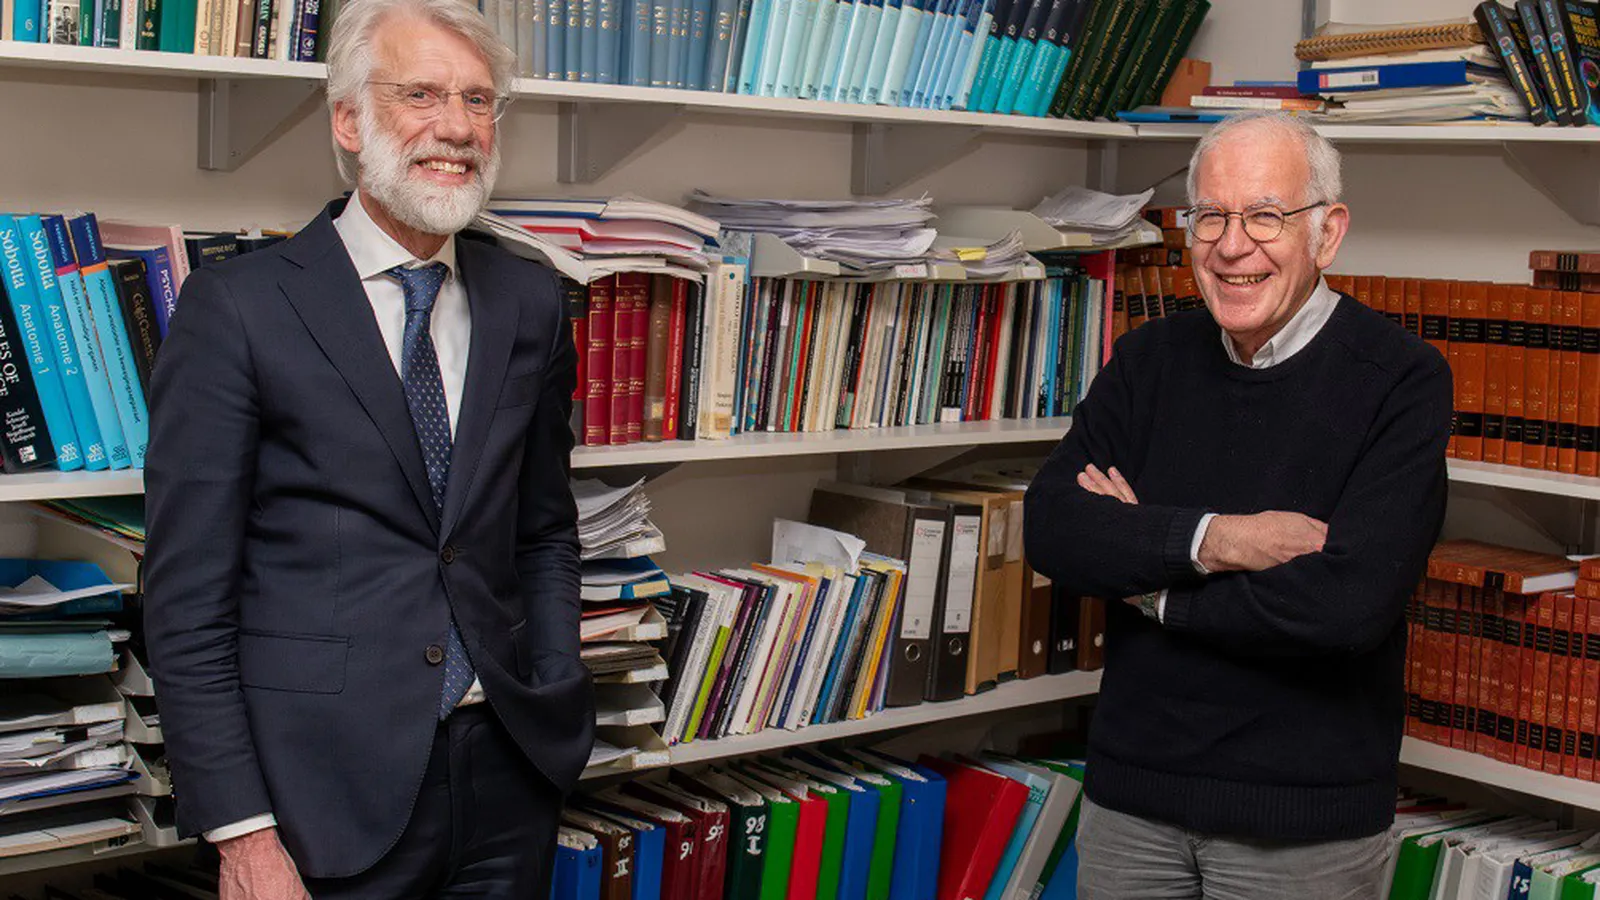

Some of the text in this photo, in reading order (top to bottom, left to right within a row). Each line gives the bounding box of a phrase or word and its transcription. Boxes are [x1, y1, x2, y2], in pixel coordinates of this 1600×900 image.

[0, 229, 50, 375] Sobotta Anatomie 1
[29, 231, 78, 376] Sobotta Anatomie 2
[3, 364, 20, 384] OF
[745, 814, 766, 834] 98
